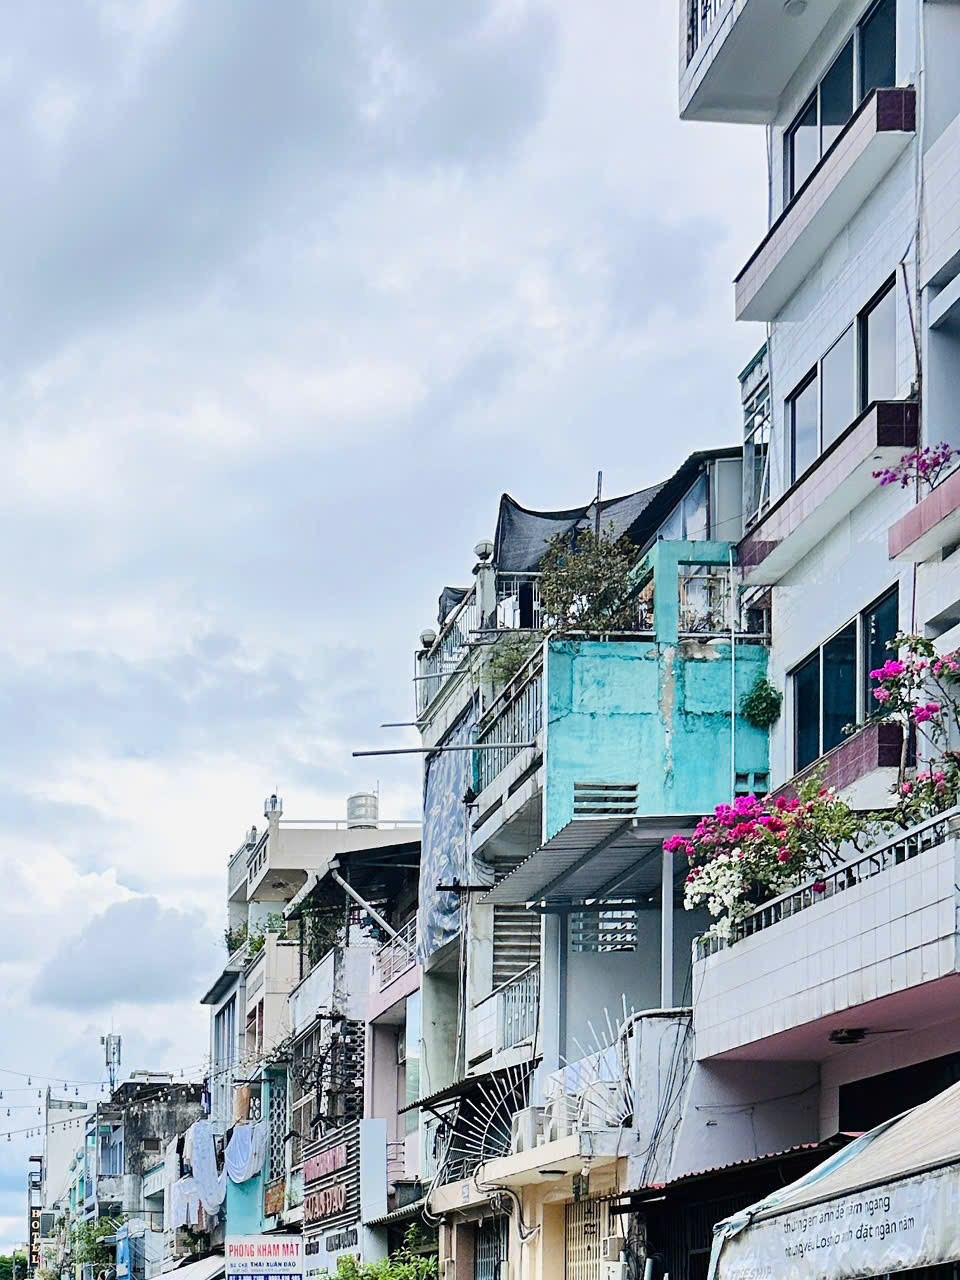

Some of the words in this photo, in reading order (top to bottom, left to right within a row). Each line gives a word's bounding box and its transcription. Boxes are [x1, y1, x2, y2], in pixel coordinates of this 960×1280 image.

[864, 1196, 890, 1216] ngang
[31, 1209, 40, 1264] HOTEL
[855, 1223, 874, 1242] đặt
[874, 1219, 897, 1241] ngàn
